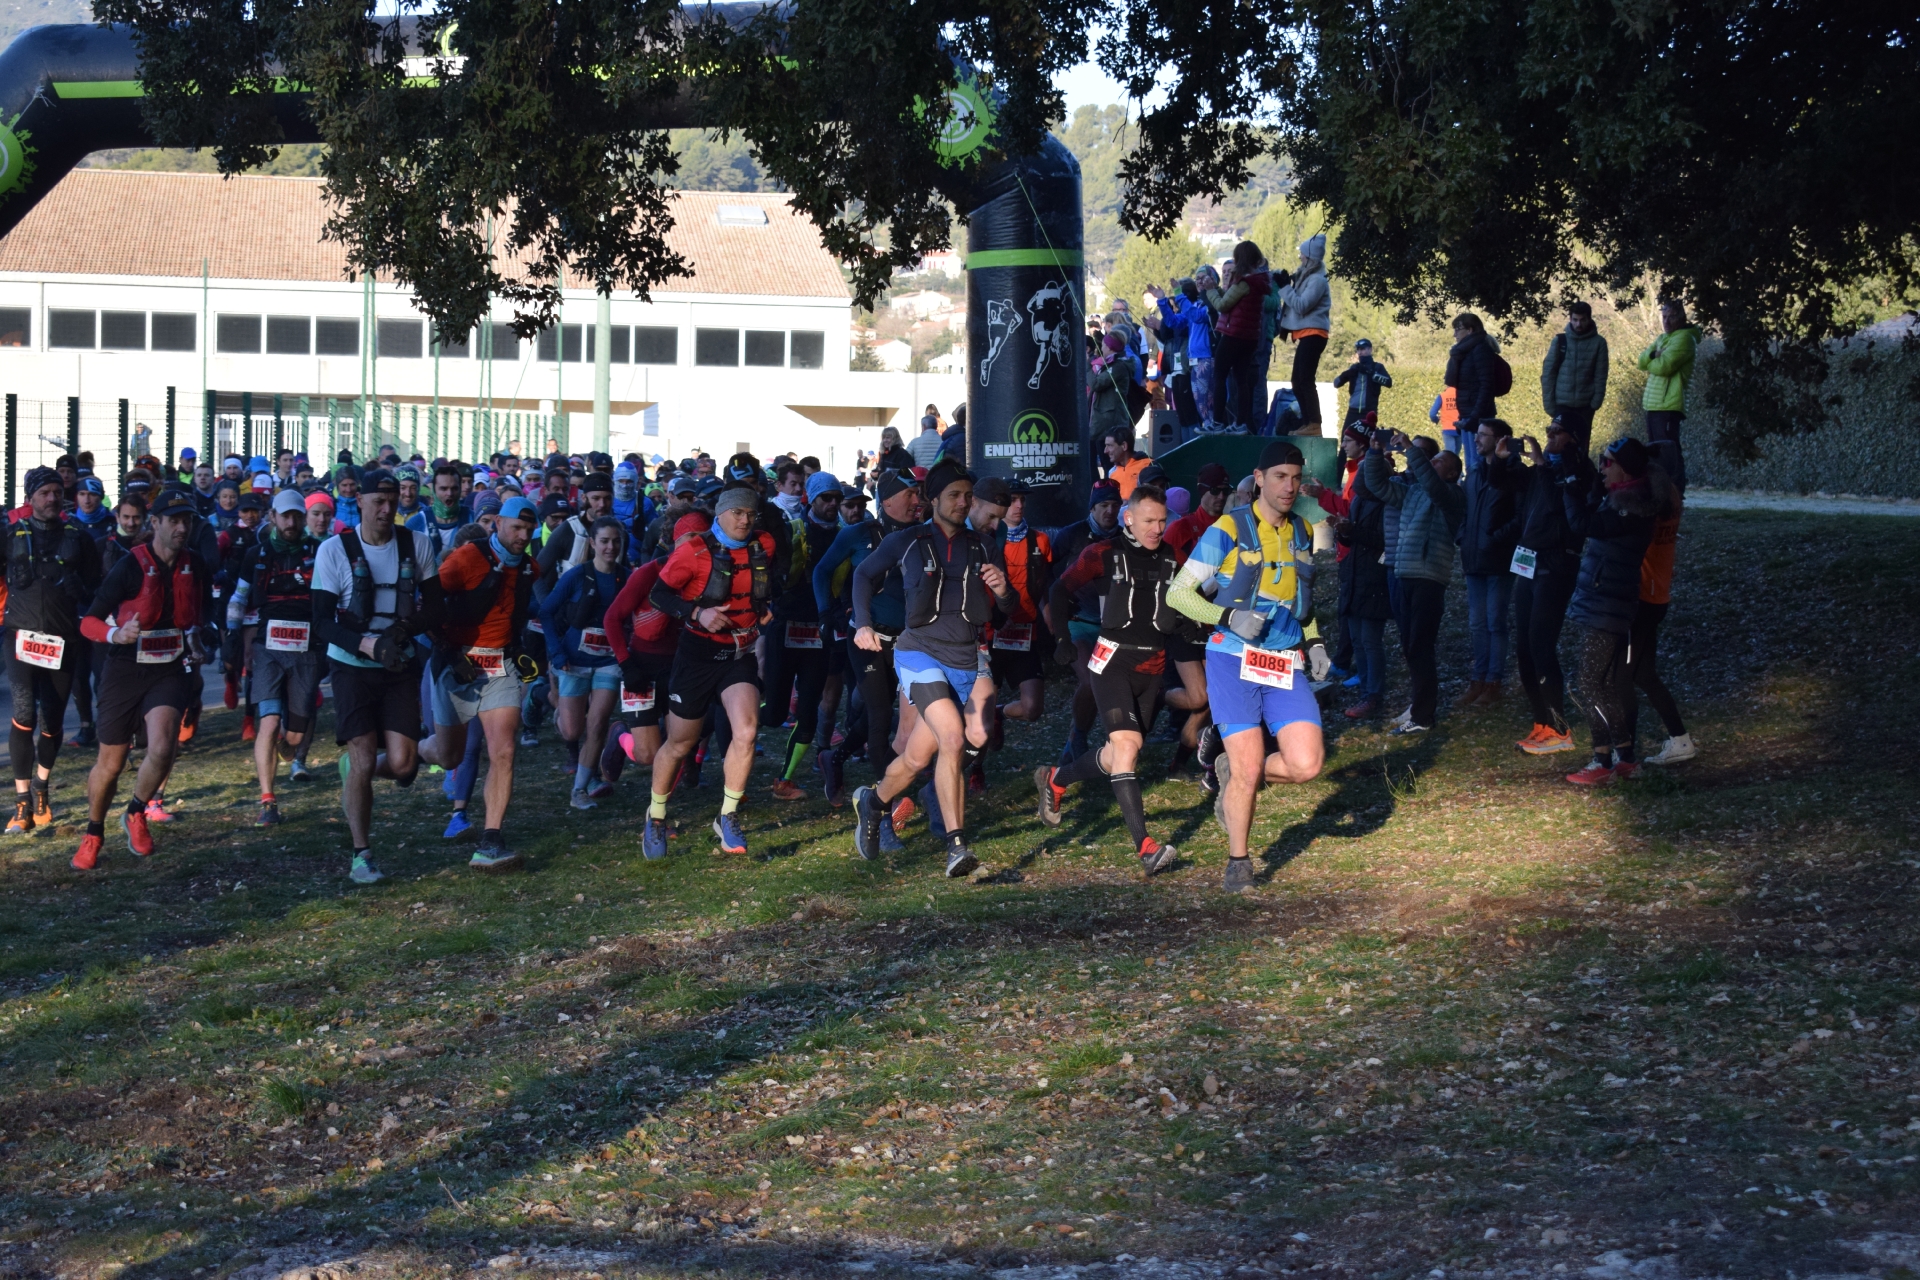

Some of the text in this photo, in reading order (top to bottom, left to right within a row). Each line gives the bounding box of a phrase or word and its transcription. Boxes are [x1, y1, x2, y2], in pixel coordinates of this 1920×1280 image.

[984, 442, 1080, 457] ENDURANCE
[1012, 455, 1056, 468] SHOP
[1034, 470, 1073, 485] Running
[273, 627, 303, 640] 3048
[25, 642, 56, 657] 3073
[145, 635, 177, 650] 3048
[1249, 652, 1286, 673] 3089
